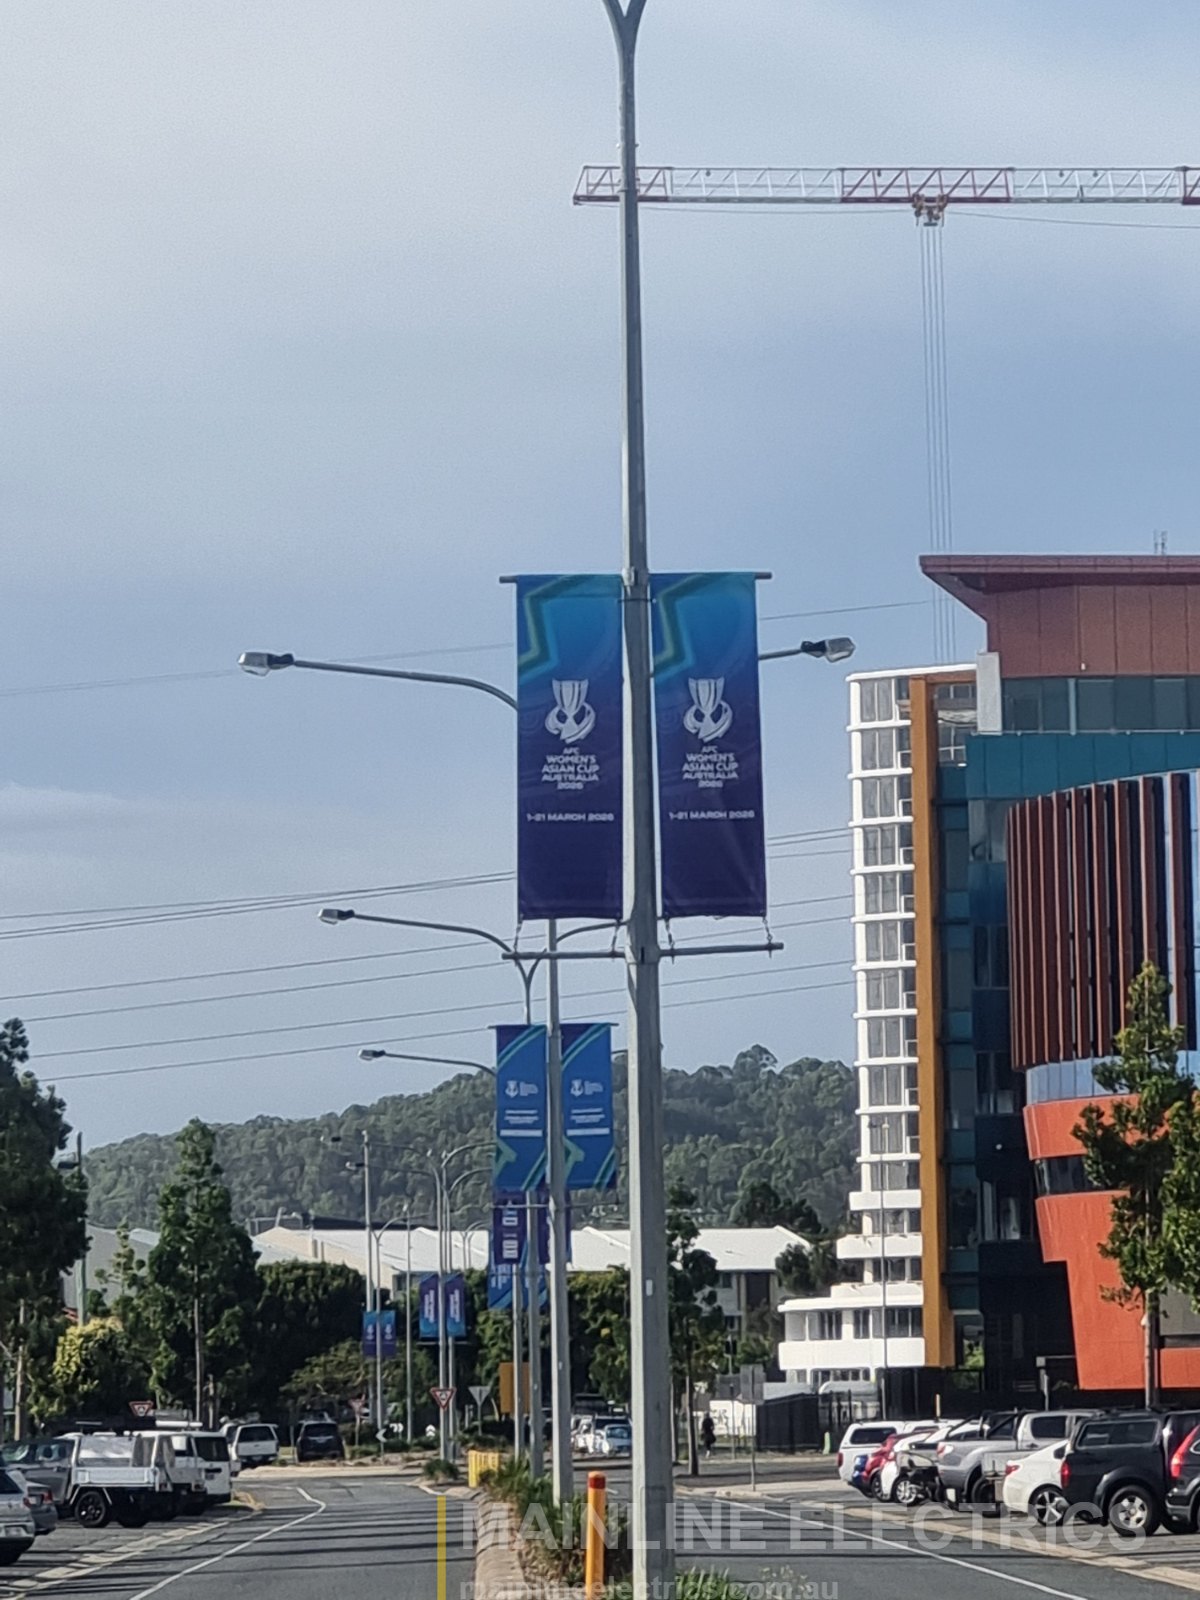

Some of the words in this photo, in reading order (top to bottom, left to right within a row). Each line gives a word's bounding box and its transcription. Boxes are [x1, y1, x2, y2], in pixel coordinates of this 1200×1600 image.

[541, 764, 575, 773] ASIAN
[577, 764, 600, 773] CUP
[682, 762, 715, 772] ASIAN
[716, 762, 739, 772] CUP
[682, 771, 739, 780] AUSTRALIA
[547, 813, 586, 822] MARCH
[689, 811, 727, 820] MARCH
